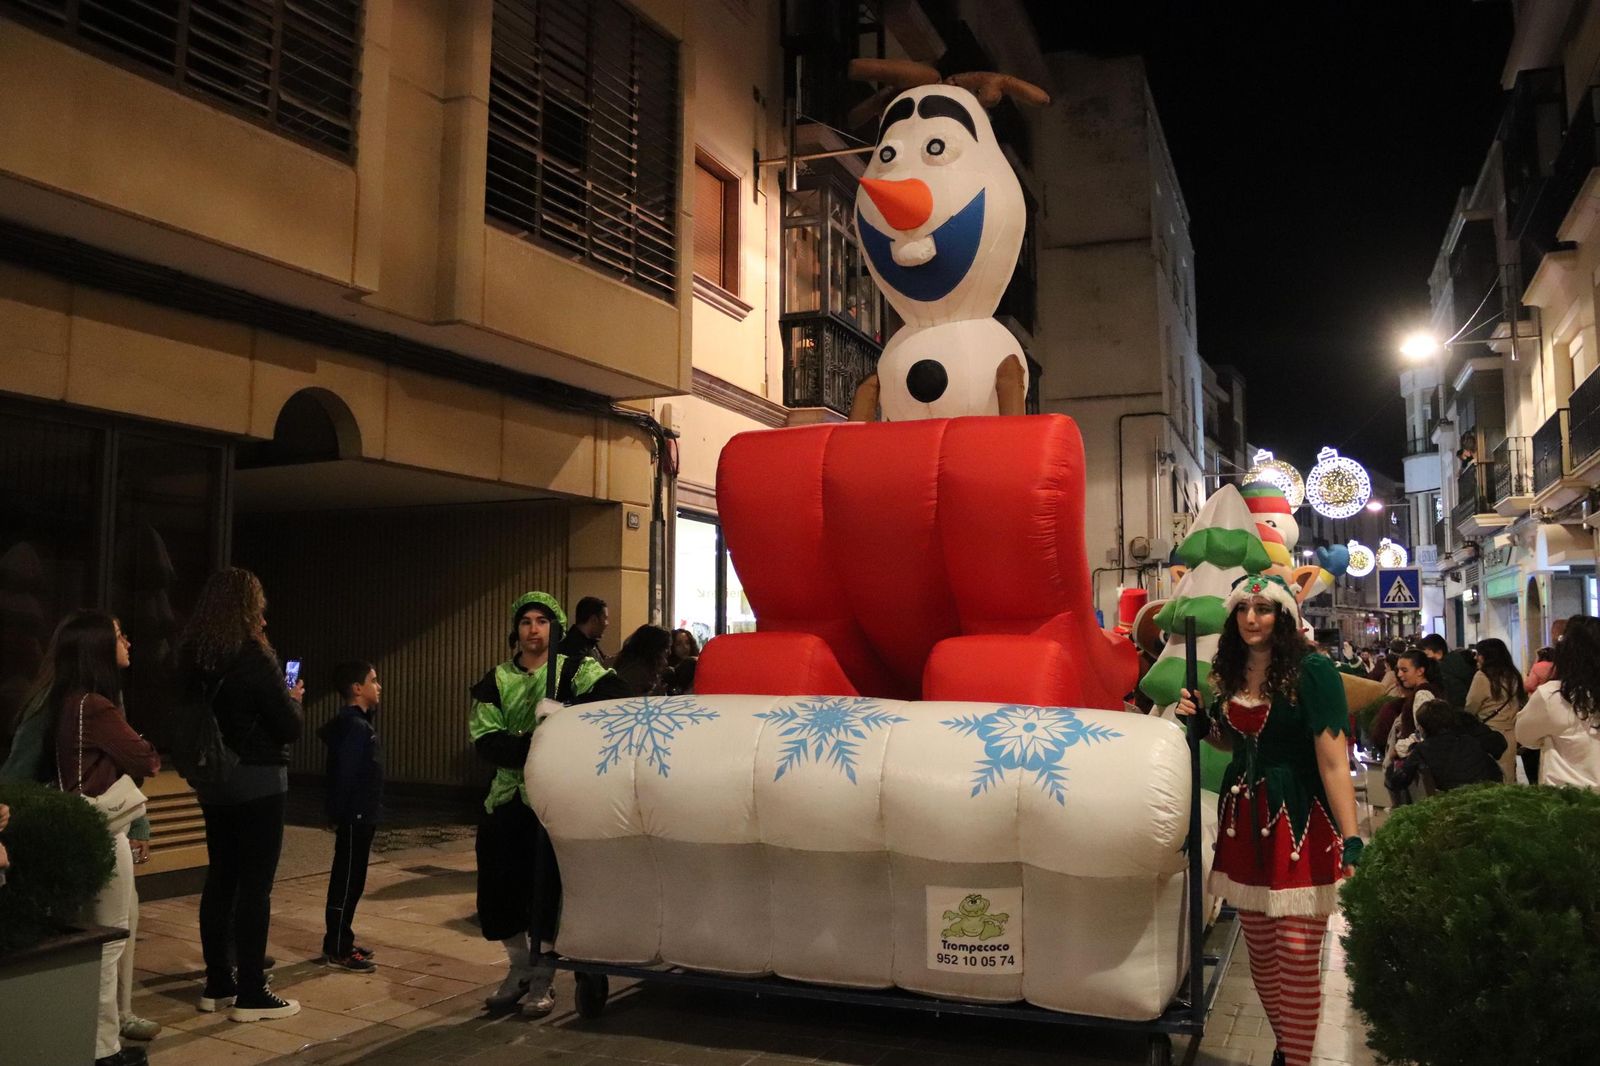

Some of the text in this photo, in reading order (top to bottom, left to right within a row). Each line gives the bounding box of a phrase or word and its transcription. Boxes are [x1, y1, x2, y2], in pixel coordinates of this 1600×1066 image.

[941, 939, 1010, 954] Trompecoco
[936, 953, 1015, 967] 952 10 05 74
